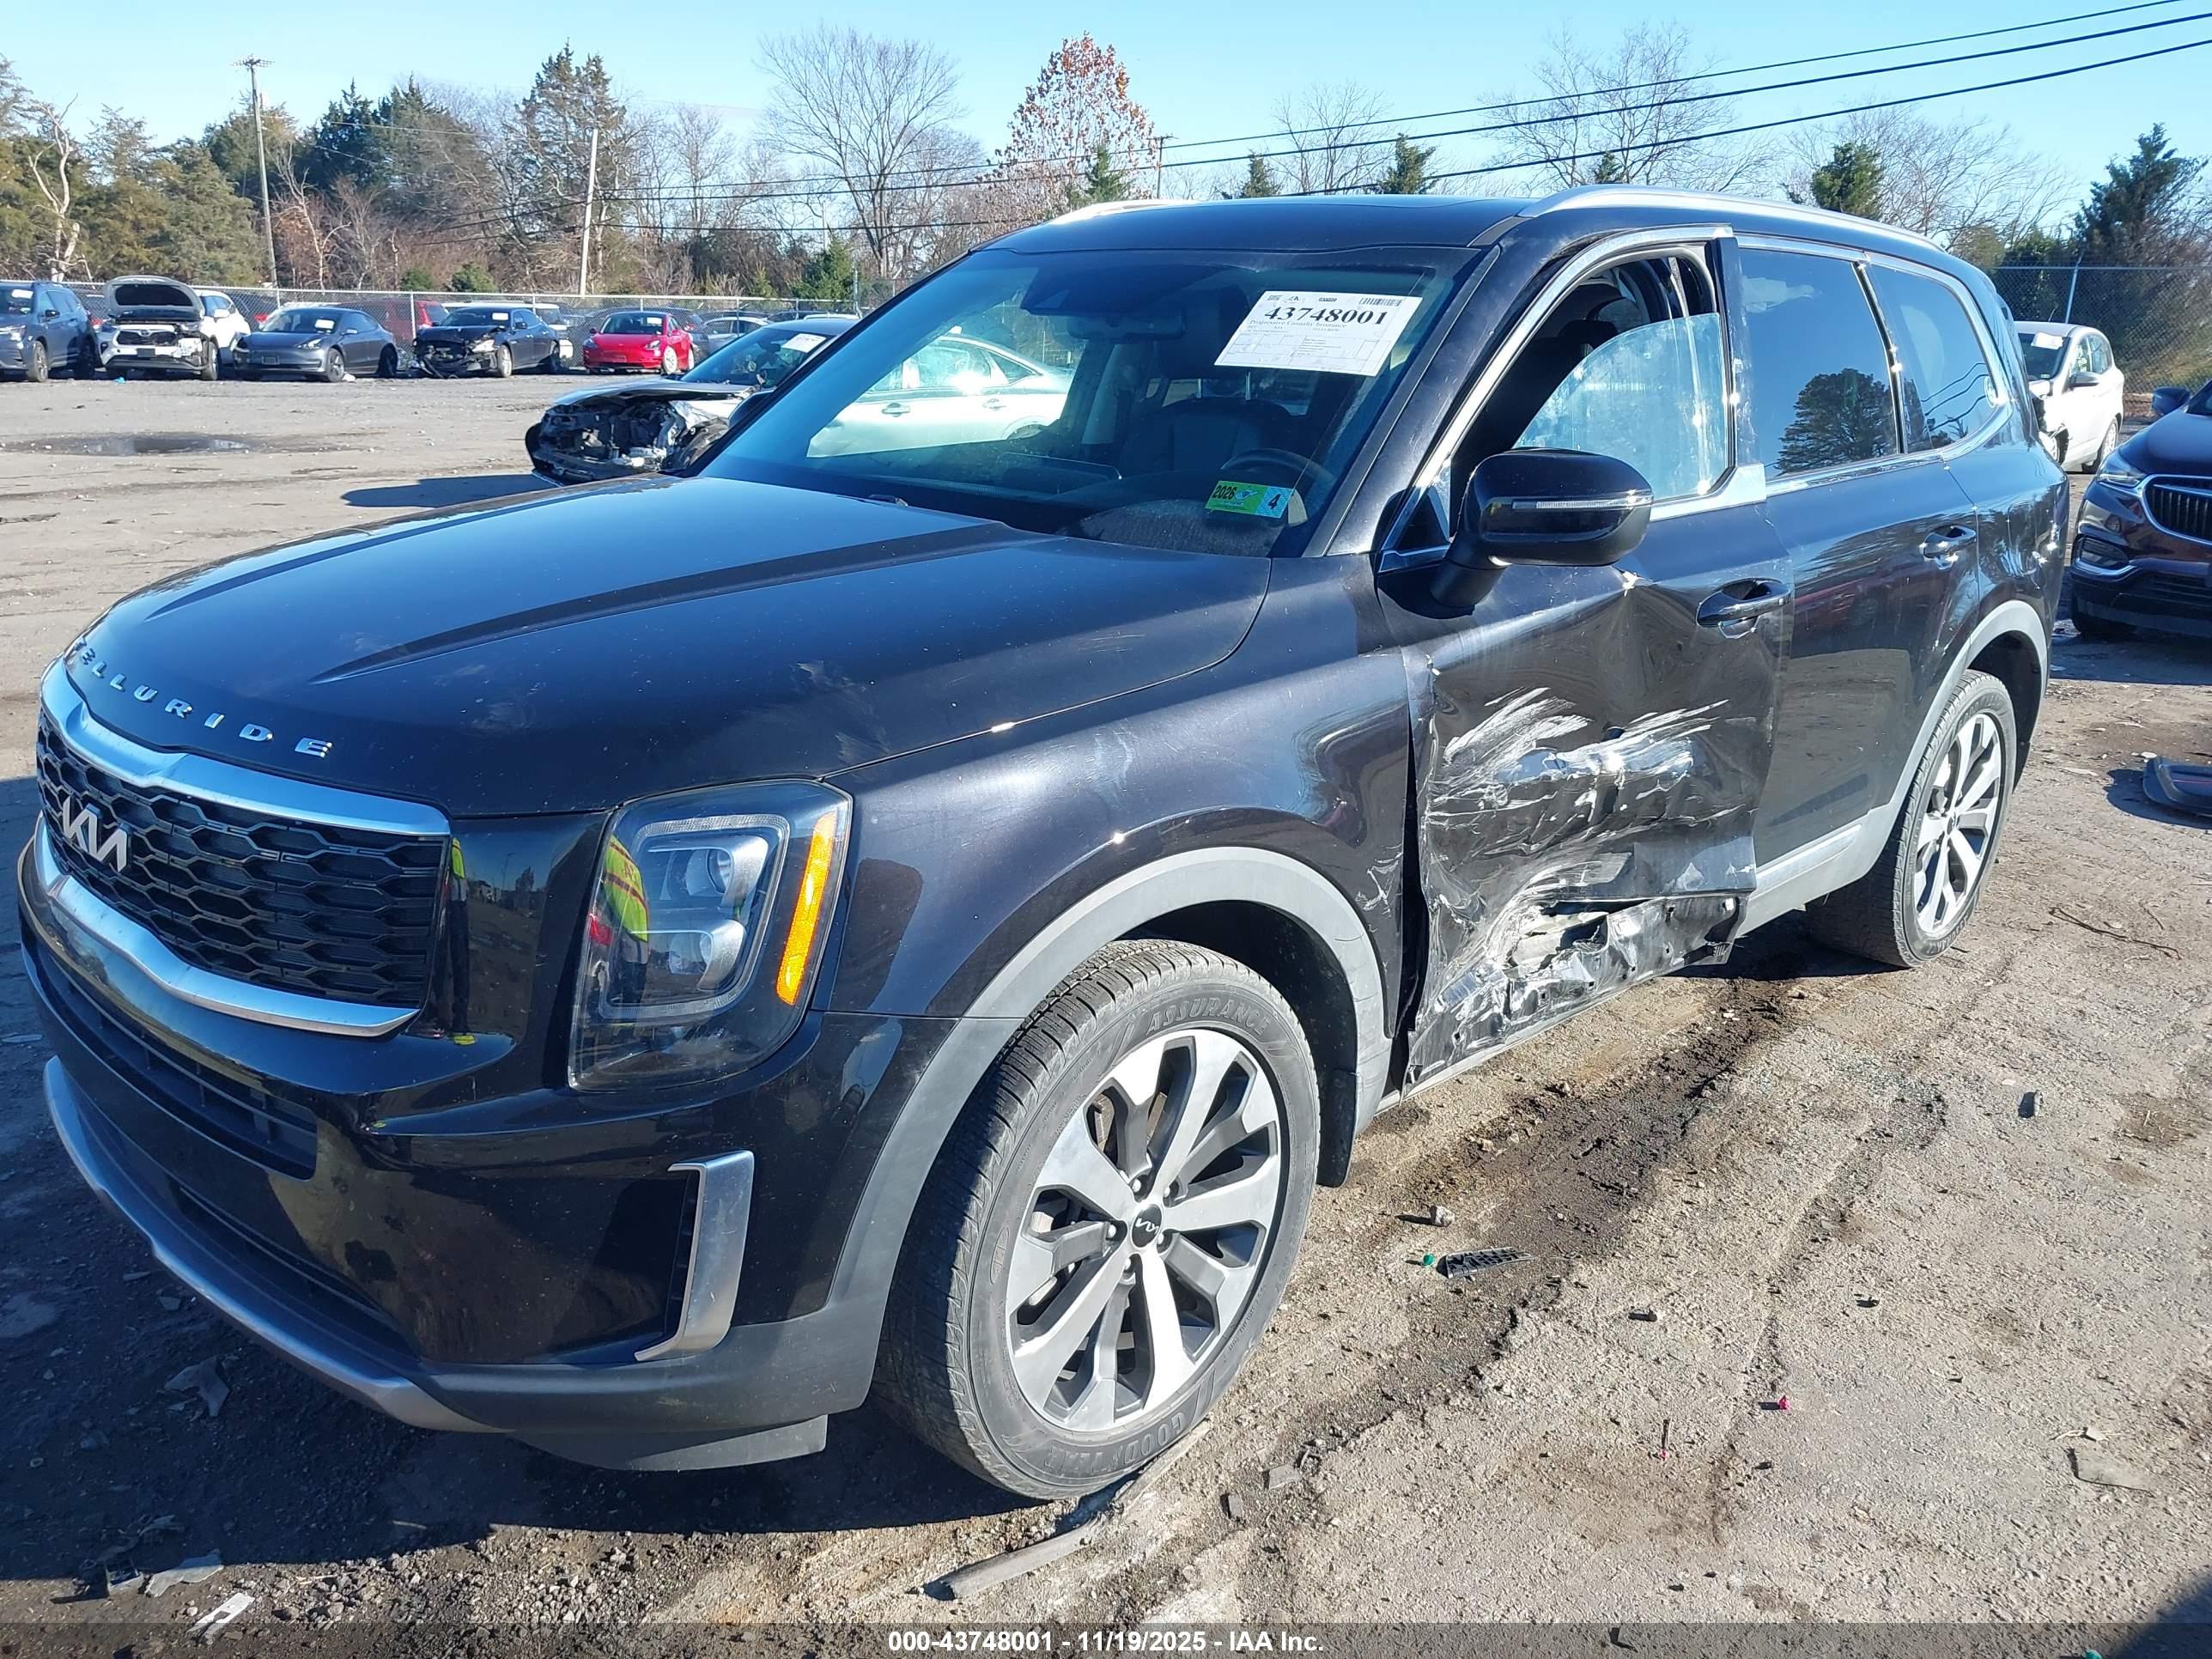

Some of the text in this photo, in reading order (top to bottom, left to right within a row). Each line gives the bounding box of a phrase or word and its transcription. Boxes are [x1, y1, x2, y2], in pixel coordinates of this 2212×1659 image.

[1264, 307, 1389, 325] 43748001
[1268, 493, 1282, 509] 4
[1146, 996, 1272, 1036] ASSURANCE
